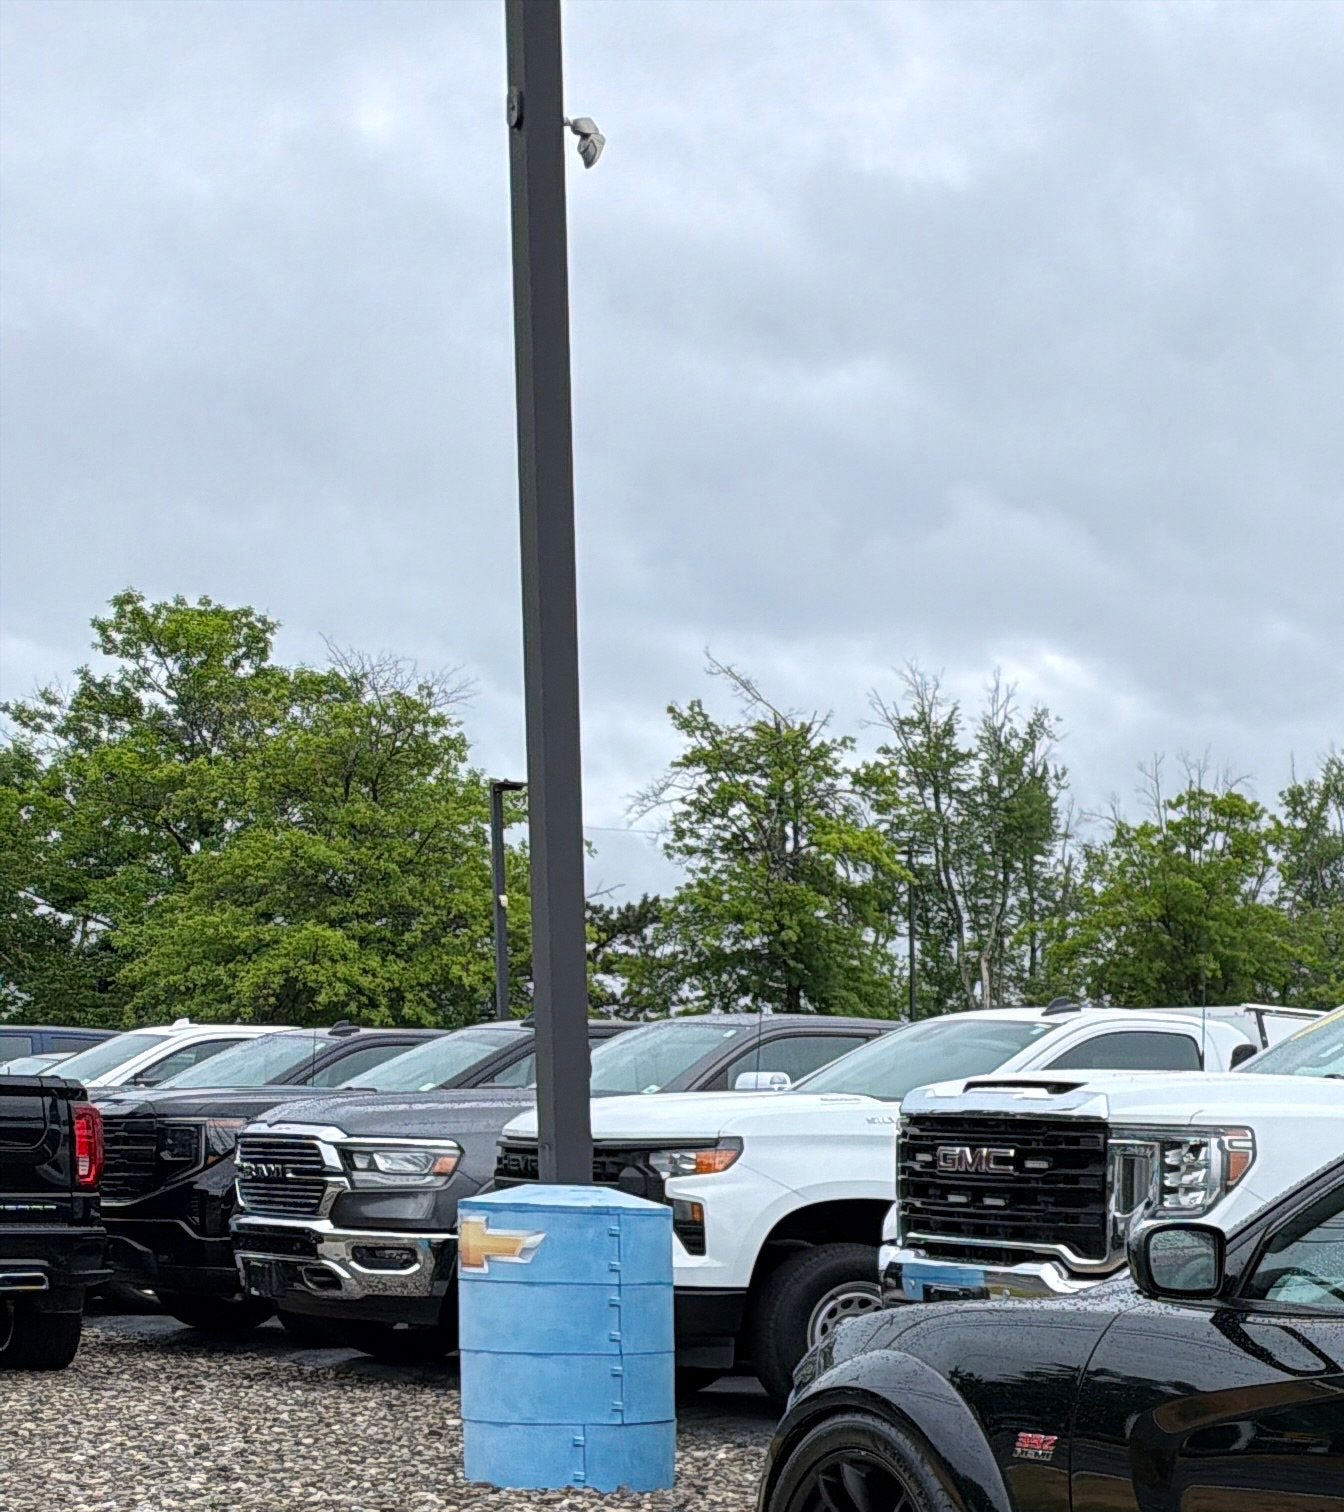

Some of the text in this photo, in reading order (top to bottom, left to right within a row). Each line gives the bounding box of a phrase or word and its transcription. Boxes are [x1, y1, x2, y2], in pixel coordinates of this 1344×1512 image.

[936, 1145, 1015, 1174] GMC
[240, 1162, 284, 1179] RAM
[1016, 1431, 1058, 1450] 392
